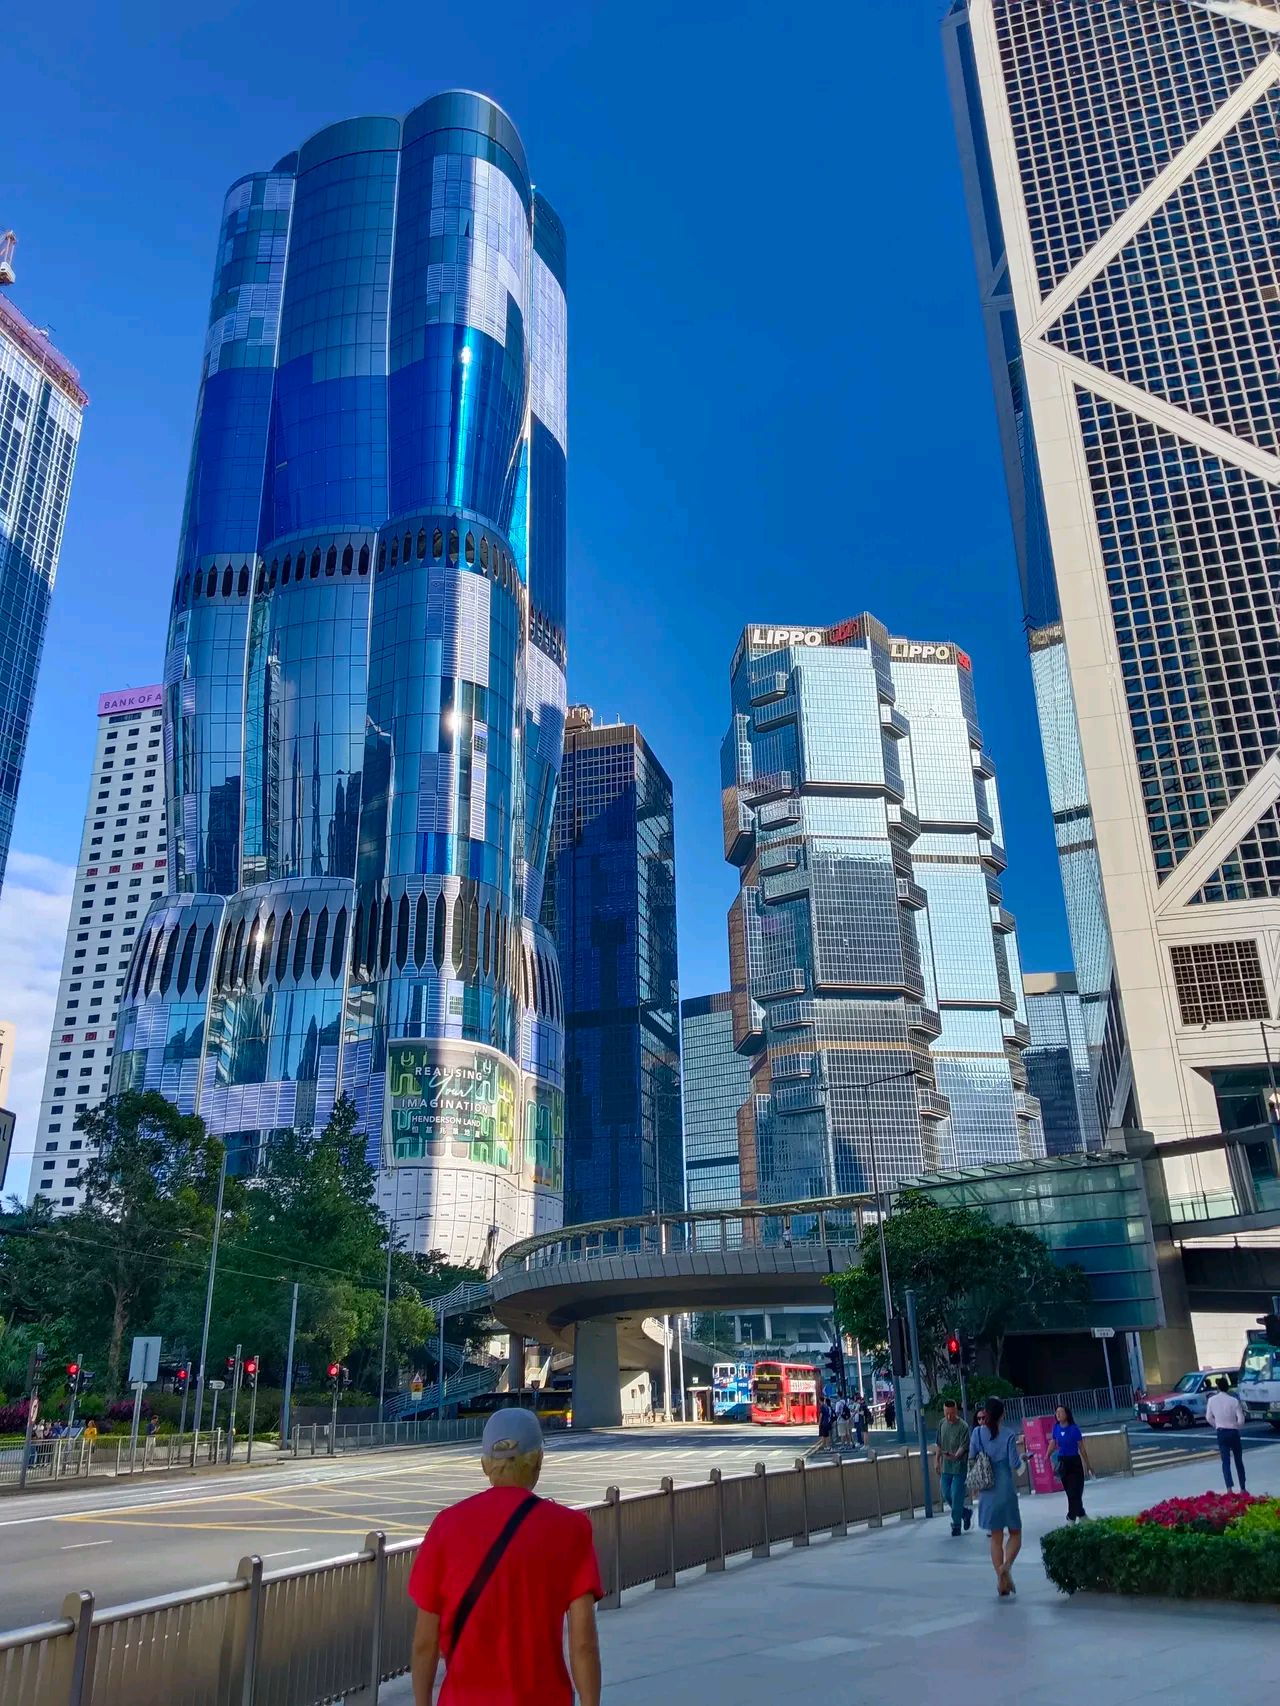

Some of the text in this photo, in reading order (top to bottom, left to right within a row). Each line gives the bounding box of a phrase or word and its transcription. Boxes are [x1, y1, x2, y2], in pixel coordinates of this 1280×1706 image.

[752, 628, 822, 647] LIPPO
[890, 644, 950, 660] LIPPO
[104, 697, 135, 709] BANK
[138, 694, 153, 704] OF
[415, 1066, 483, 1081] REALISING
[402, 1099, 487, 1113] IMAGINATION
[412, 1115, 481, 1128] HENDERSON LAND
